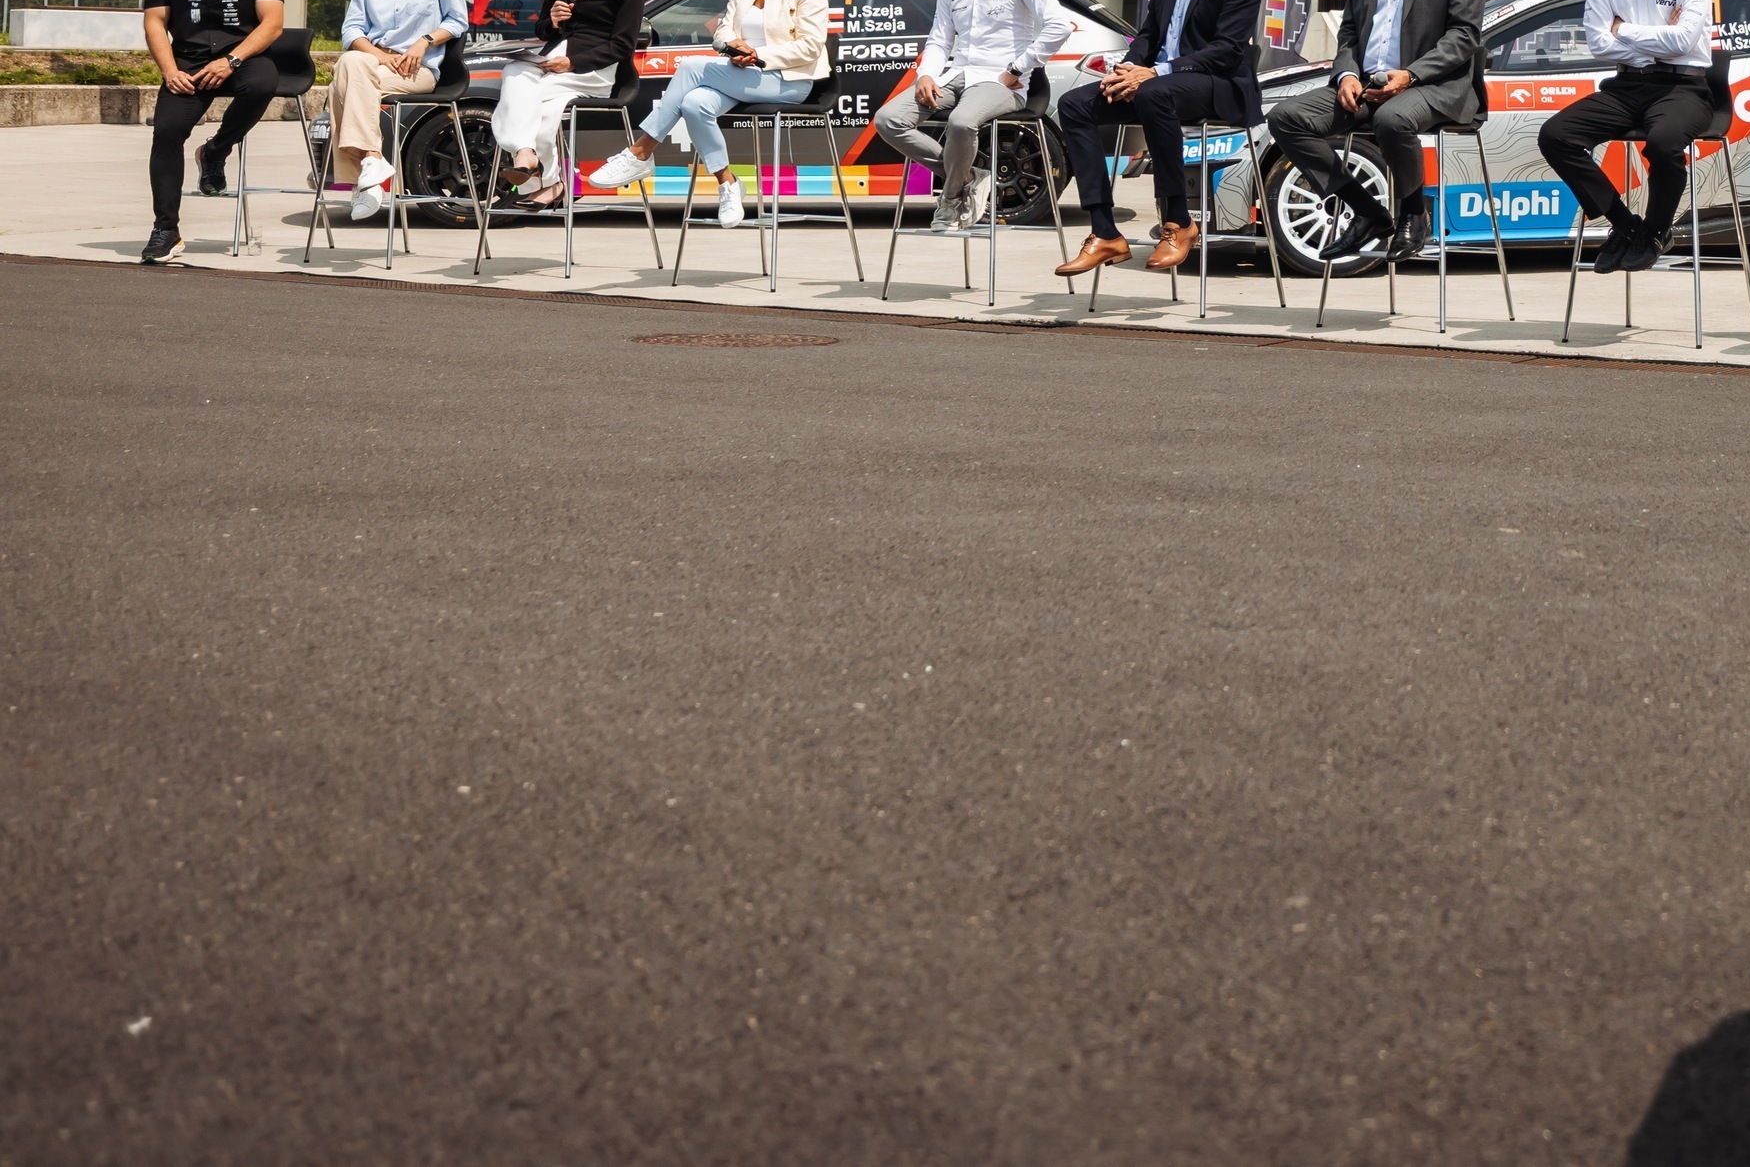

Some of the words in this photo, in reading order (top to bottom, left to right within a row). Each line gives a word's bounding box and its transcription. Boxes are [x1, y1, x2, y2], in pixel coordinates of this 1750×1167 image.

[848, 4, 903, 19] J.Szeja
[847, 19, 906, 34] M.Szeja
[845, 61, 918, 73] Przemysłowa
[1540, 87, 1576, 95] ORLEN
[780, 118, 840, 128] ezpieczeńswa
[843, 115, 870, 127] Śląska
[1460, 189, 1560, 222] Delphi
